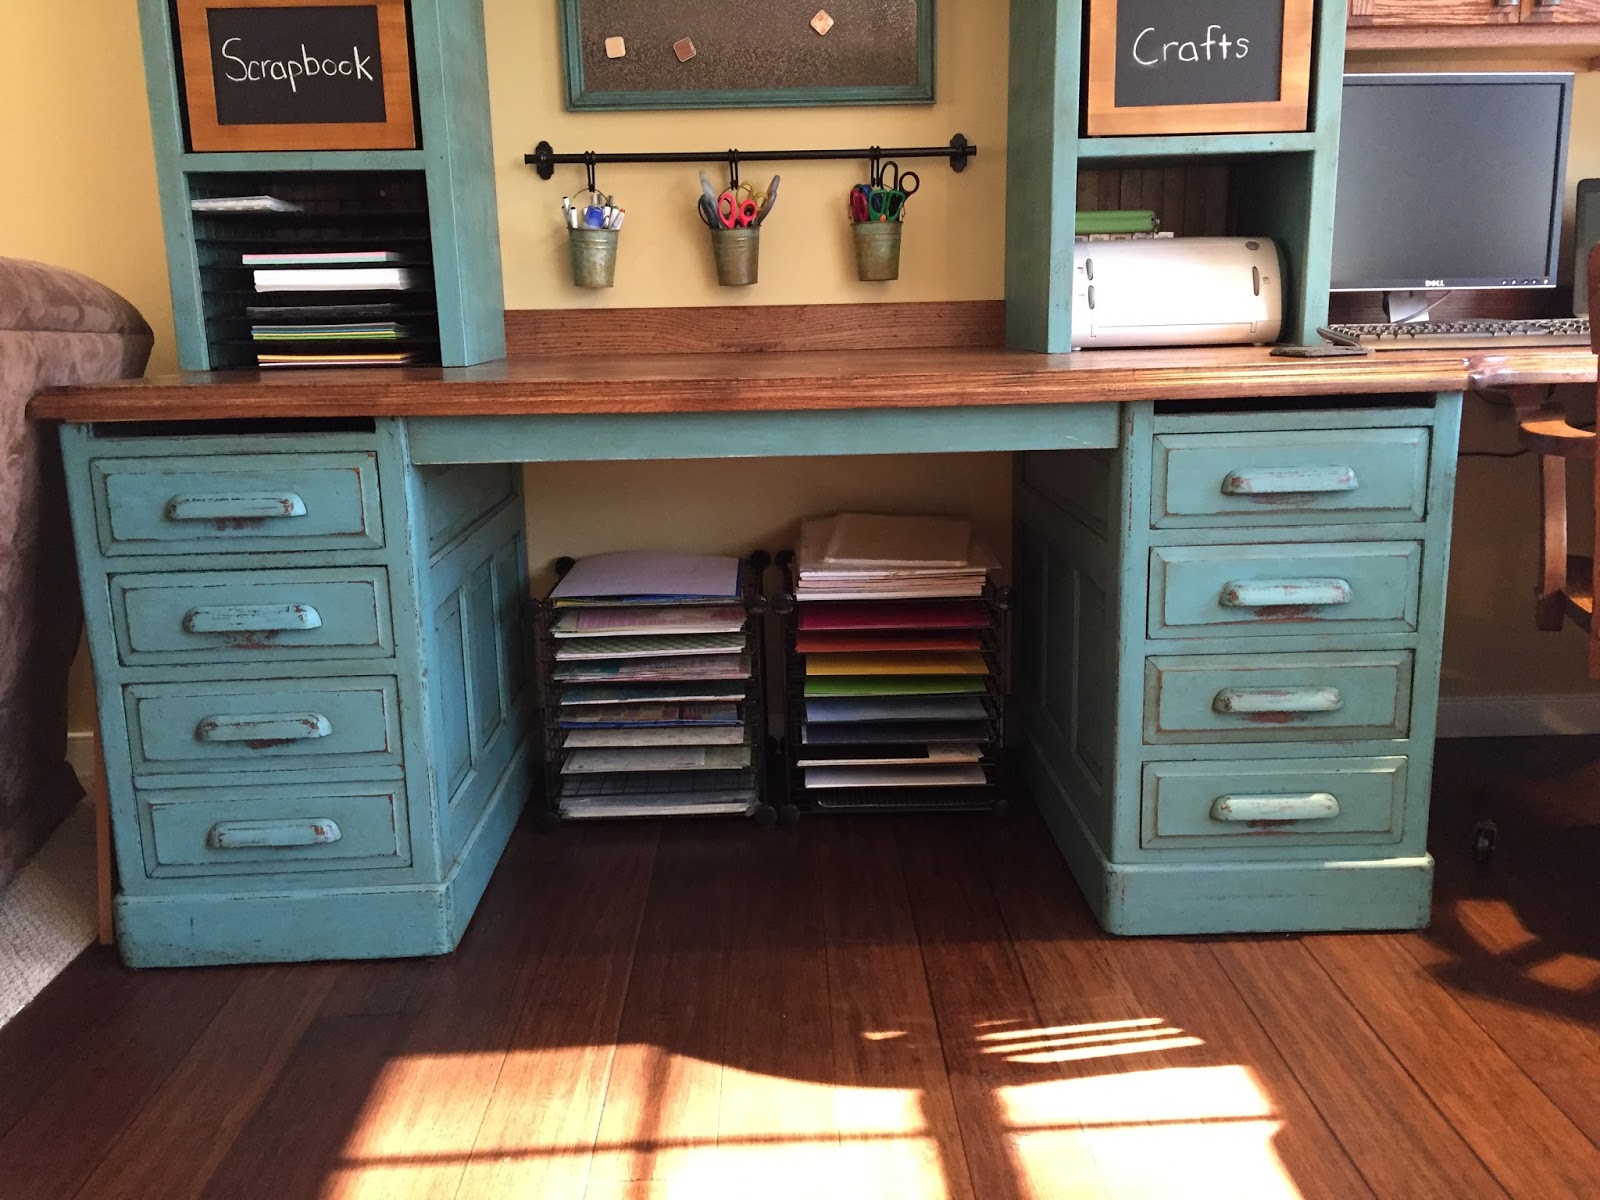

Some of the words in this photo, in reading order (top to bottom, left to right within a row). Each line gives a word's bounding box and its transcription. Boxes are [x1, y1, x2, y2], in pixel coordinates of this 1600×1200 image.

[221, 37, 374, 93] Scrapbook
[1132, 24, 1250, 66] Crafts
[1424, 279, 1445, 287] DELL
